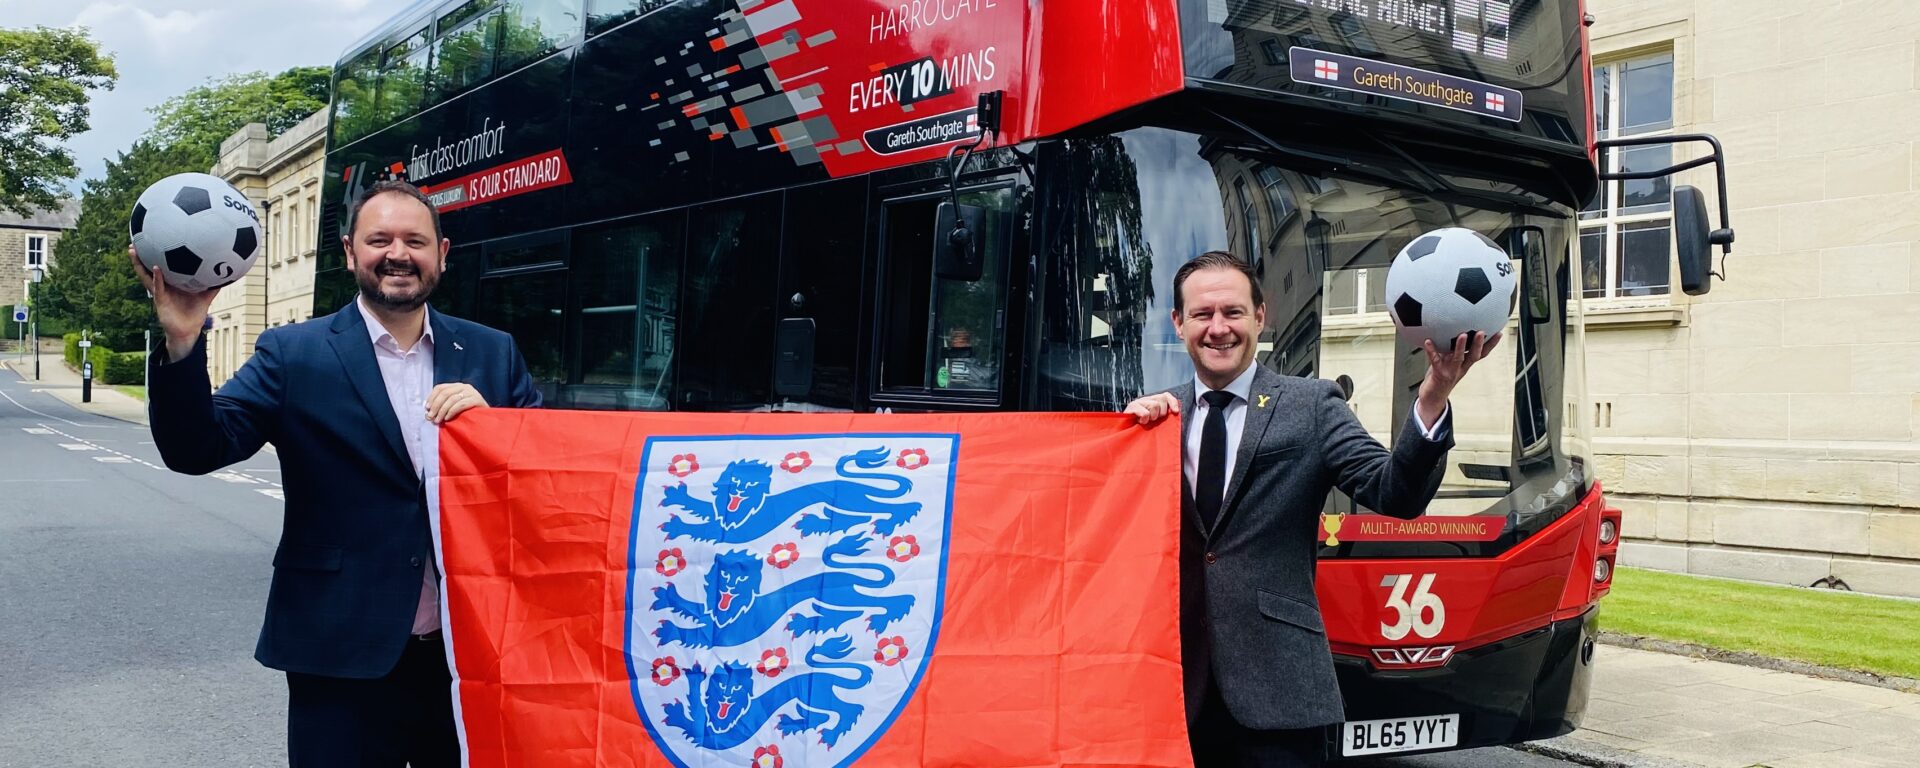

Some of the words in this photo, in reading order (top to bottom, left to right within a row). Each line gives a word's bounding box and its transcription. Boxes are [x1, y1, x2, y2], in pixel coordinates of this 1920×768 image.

[869, 0, 997, 44] HARROGA
[849, 69, 908, 113] EVERY
[910, 59, 935, 99] 10
[938, 46, 996, 92] MINS
[1353, 66, 1402, 92] Gareth
[1405, 75, 1474, 106] Southgate
[410, 144, 430, 183] first
[430, 135, 455, 176] class
[455, 117, 506, 168] comfort
[886, 126, 916, 148] Gareth
[916, 119, 963, 142] Southgate
[469, 178, 479, 201] IS
[479, 171, 501, 197] OUR
[502, 156, 561, 192] STANDARD
[1360, 521, 1438, 535] MULTI-AWARD
[1439, 522, 1487, 535] WINNING
[1380, 573, 1446, 641] 36
[1352, 721, 1407, 750] BL65
[1413, 717, 1451, 745] YYT
